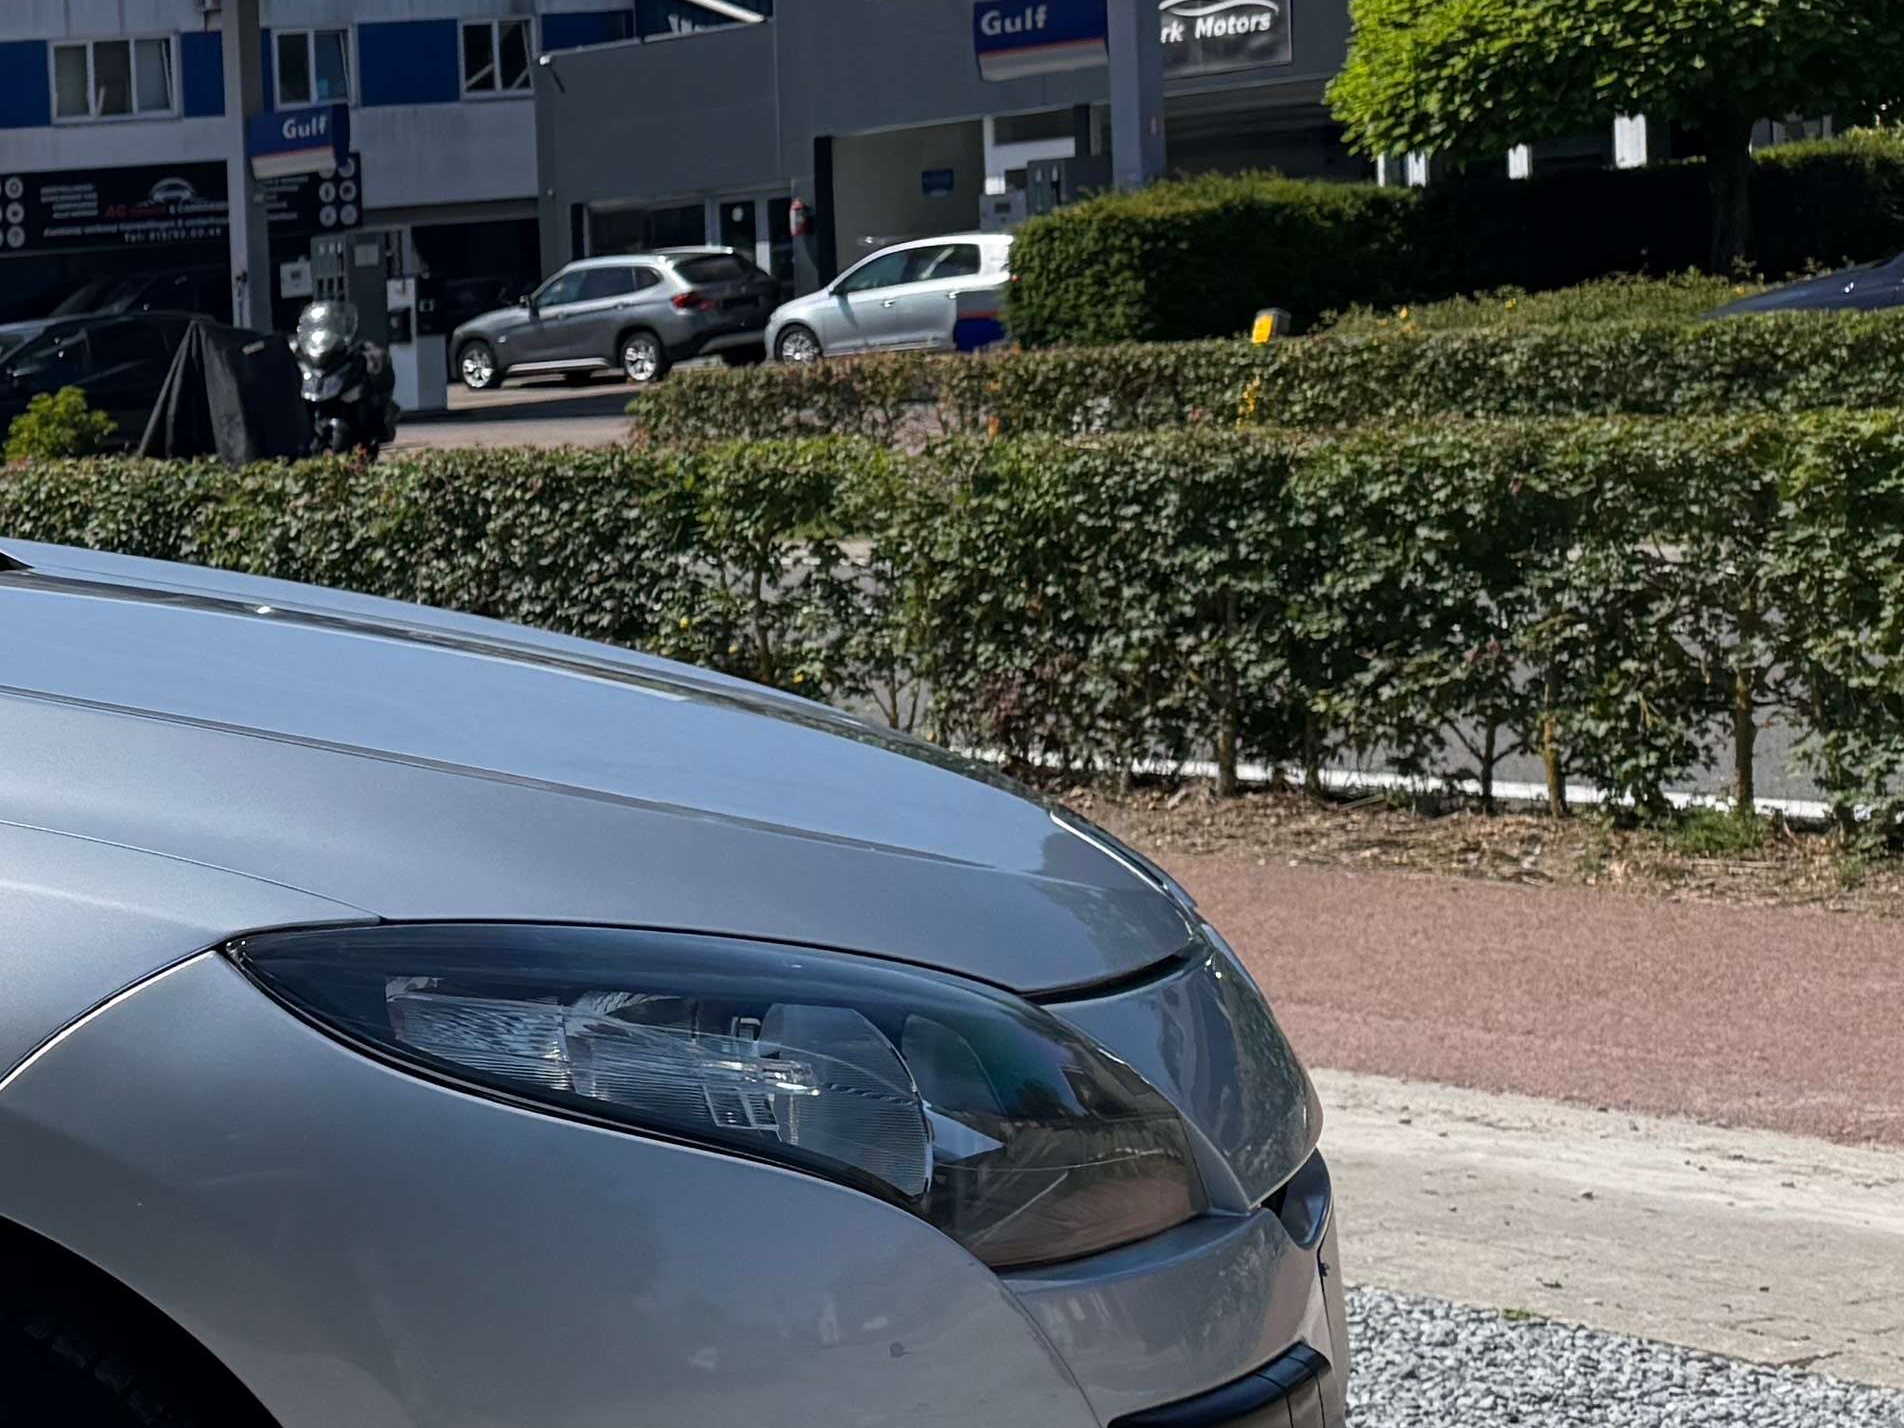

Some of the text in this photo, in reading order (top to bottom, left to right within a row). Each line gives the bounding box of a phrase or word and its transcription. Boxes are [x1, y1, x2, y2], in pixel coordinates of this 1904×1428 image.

[980, 4, 1048, 36] Gulf
[1194, 11, 1272, 40] Motors
[282, 115, 328, 140] Gulf
